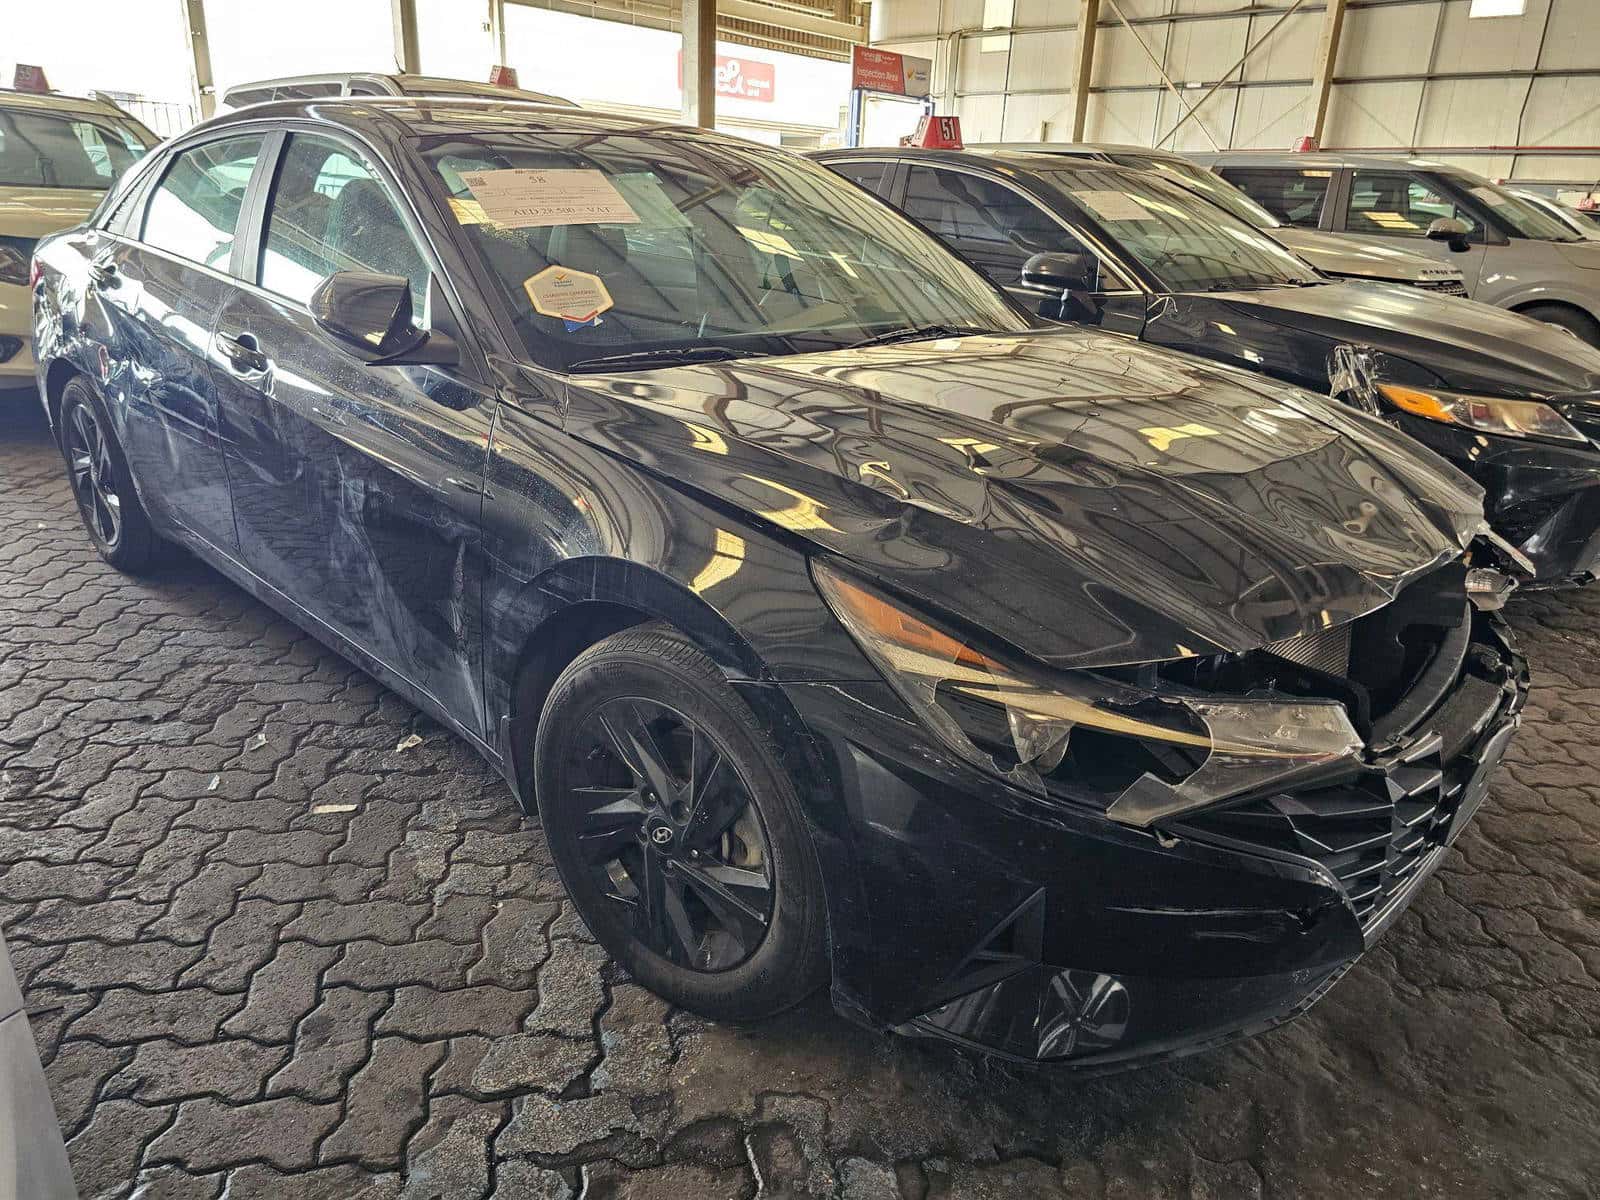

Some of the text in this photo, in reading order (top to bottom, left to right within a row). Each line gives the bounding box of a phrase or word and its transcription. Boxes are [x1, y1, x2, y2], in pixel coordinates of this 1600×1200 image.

[856, 66, 886, 80] Inspection
[941, 118, 956, 140] 51
[513, 207, 540, 216] AED
